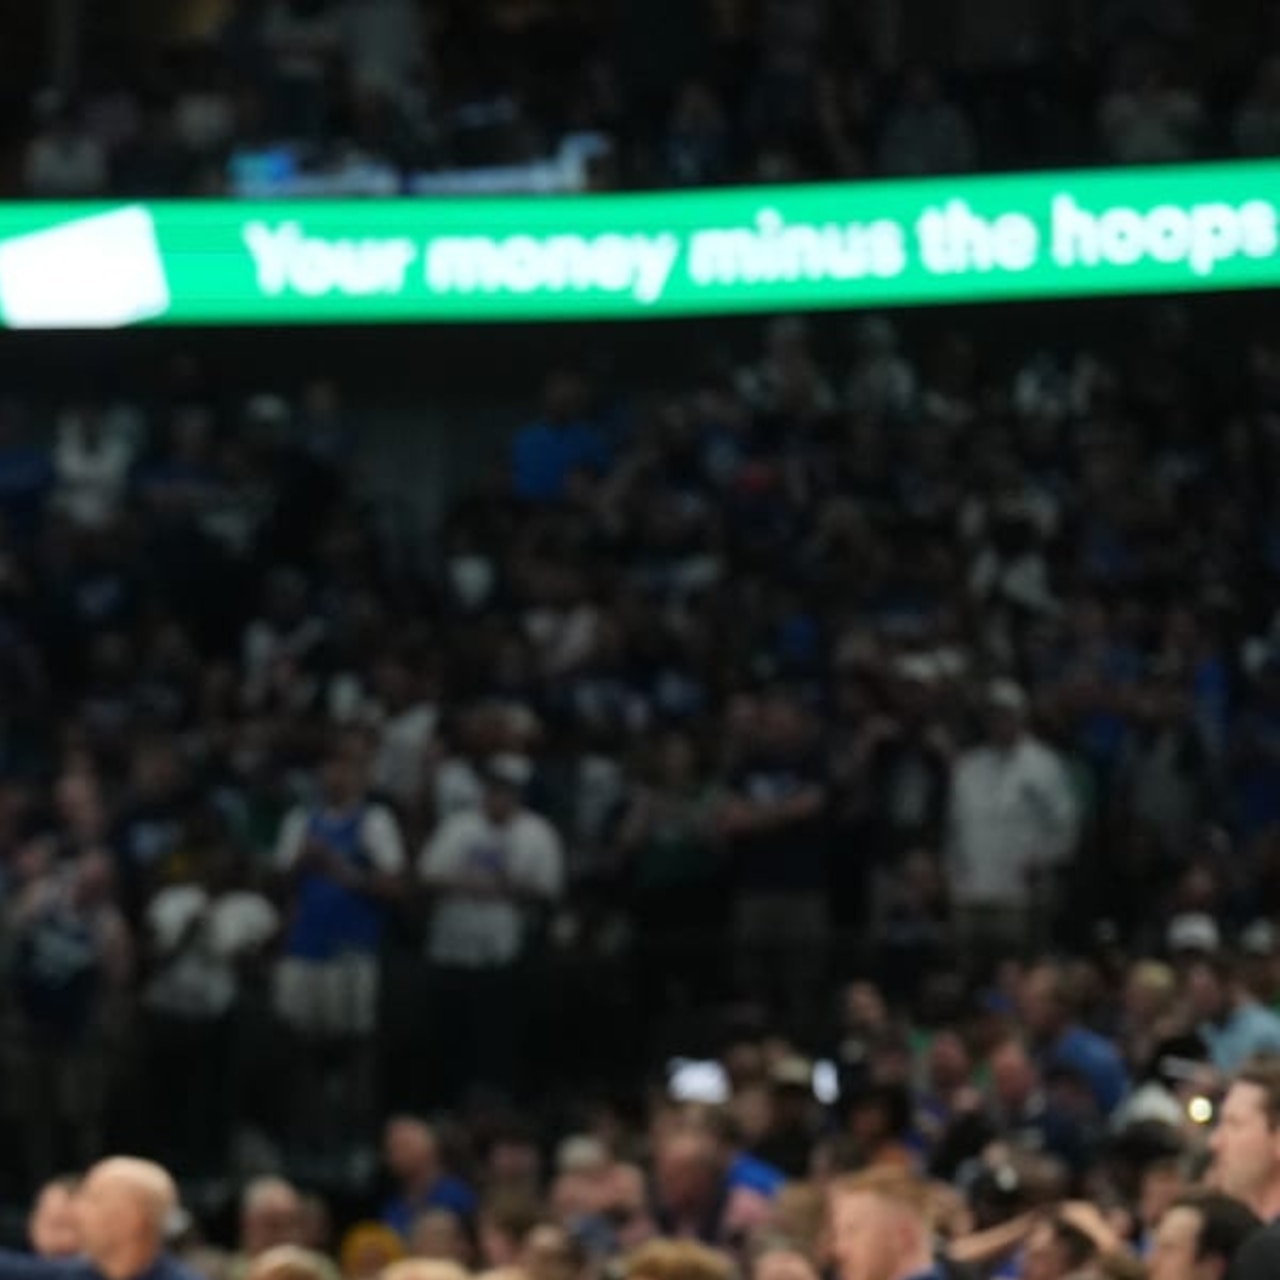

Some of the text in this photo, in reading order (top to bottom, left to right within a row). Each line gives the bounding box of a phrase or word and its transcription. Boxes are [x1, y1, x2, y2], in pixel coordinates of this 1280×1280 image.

[246, 195, 1278, 301] Your money minus the hoops
